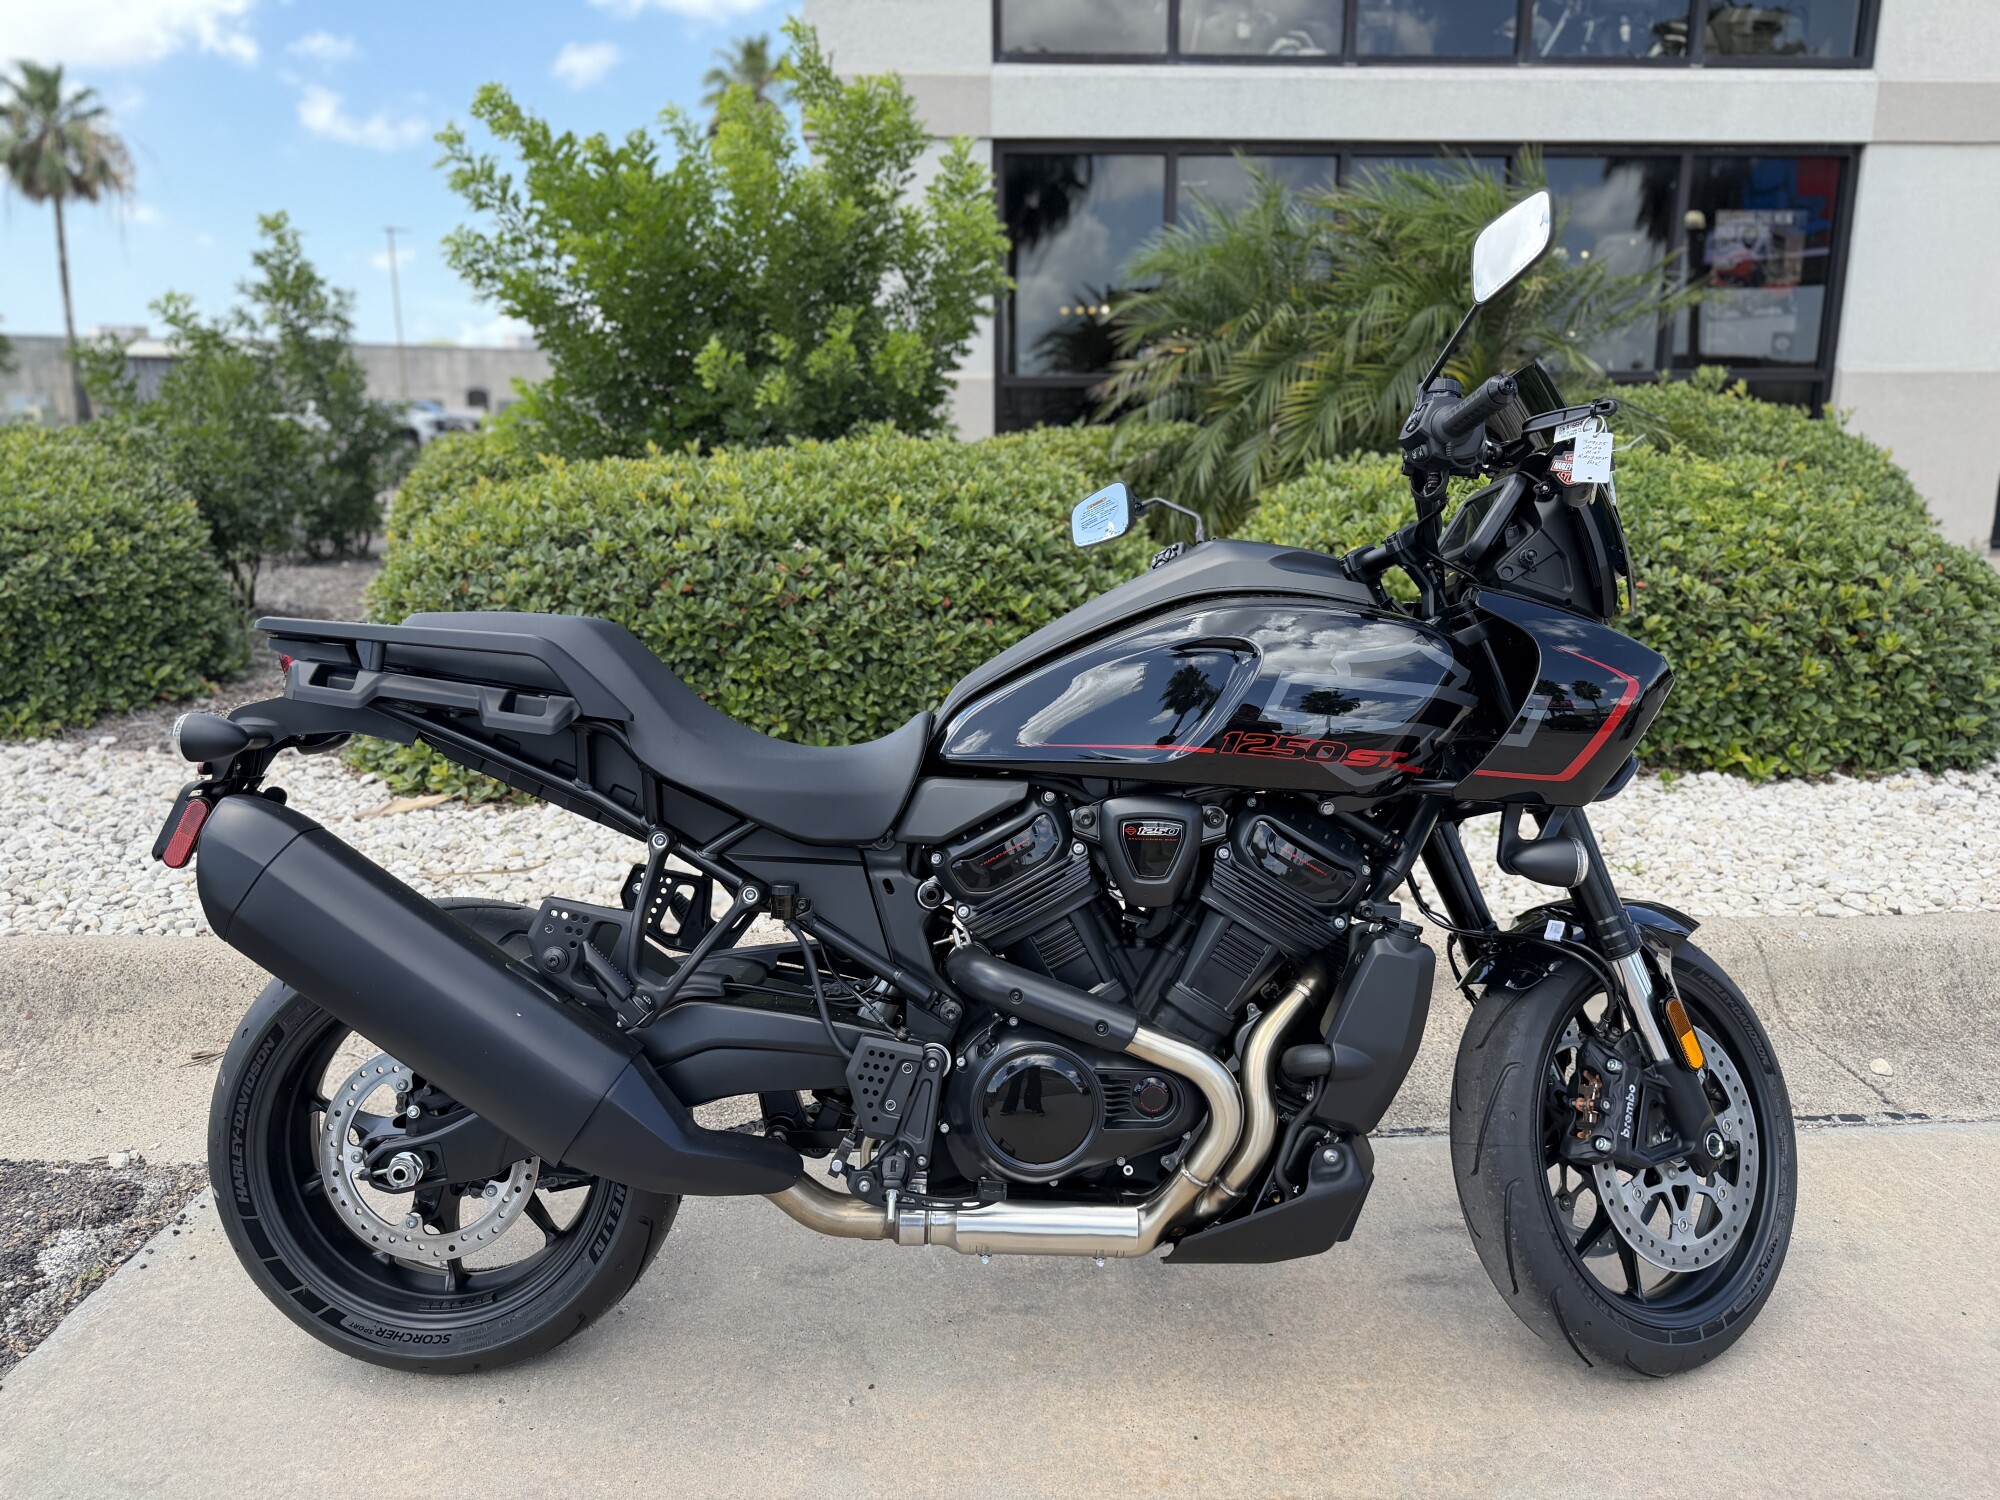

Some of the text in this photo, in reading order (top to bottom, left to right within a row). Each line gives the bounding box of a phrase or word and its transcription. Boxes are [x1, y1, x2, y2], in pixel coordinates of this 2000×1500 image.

[1137, 826, 1180, 836] 1250
[1697, 973, 1770, 1066] HARLEY-DAVIDSON
[234, 1036, 276, 1202] HARLEY-DAVIDSON
[1620, 1084, 1636, 1139] brembo
[594, 1184, 625, 1258] HELIN
[347, 1321, 375, 1335] SPORT
[374, 1326, 453, 1345] SCORCHER
